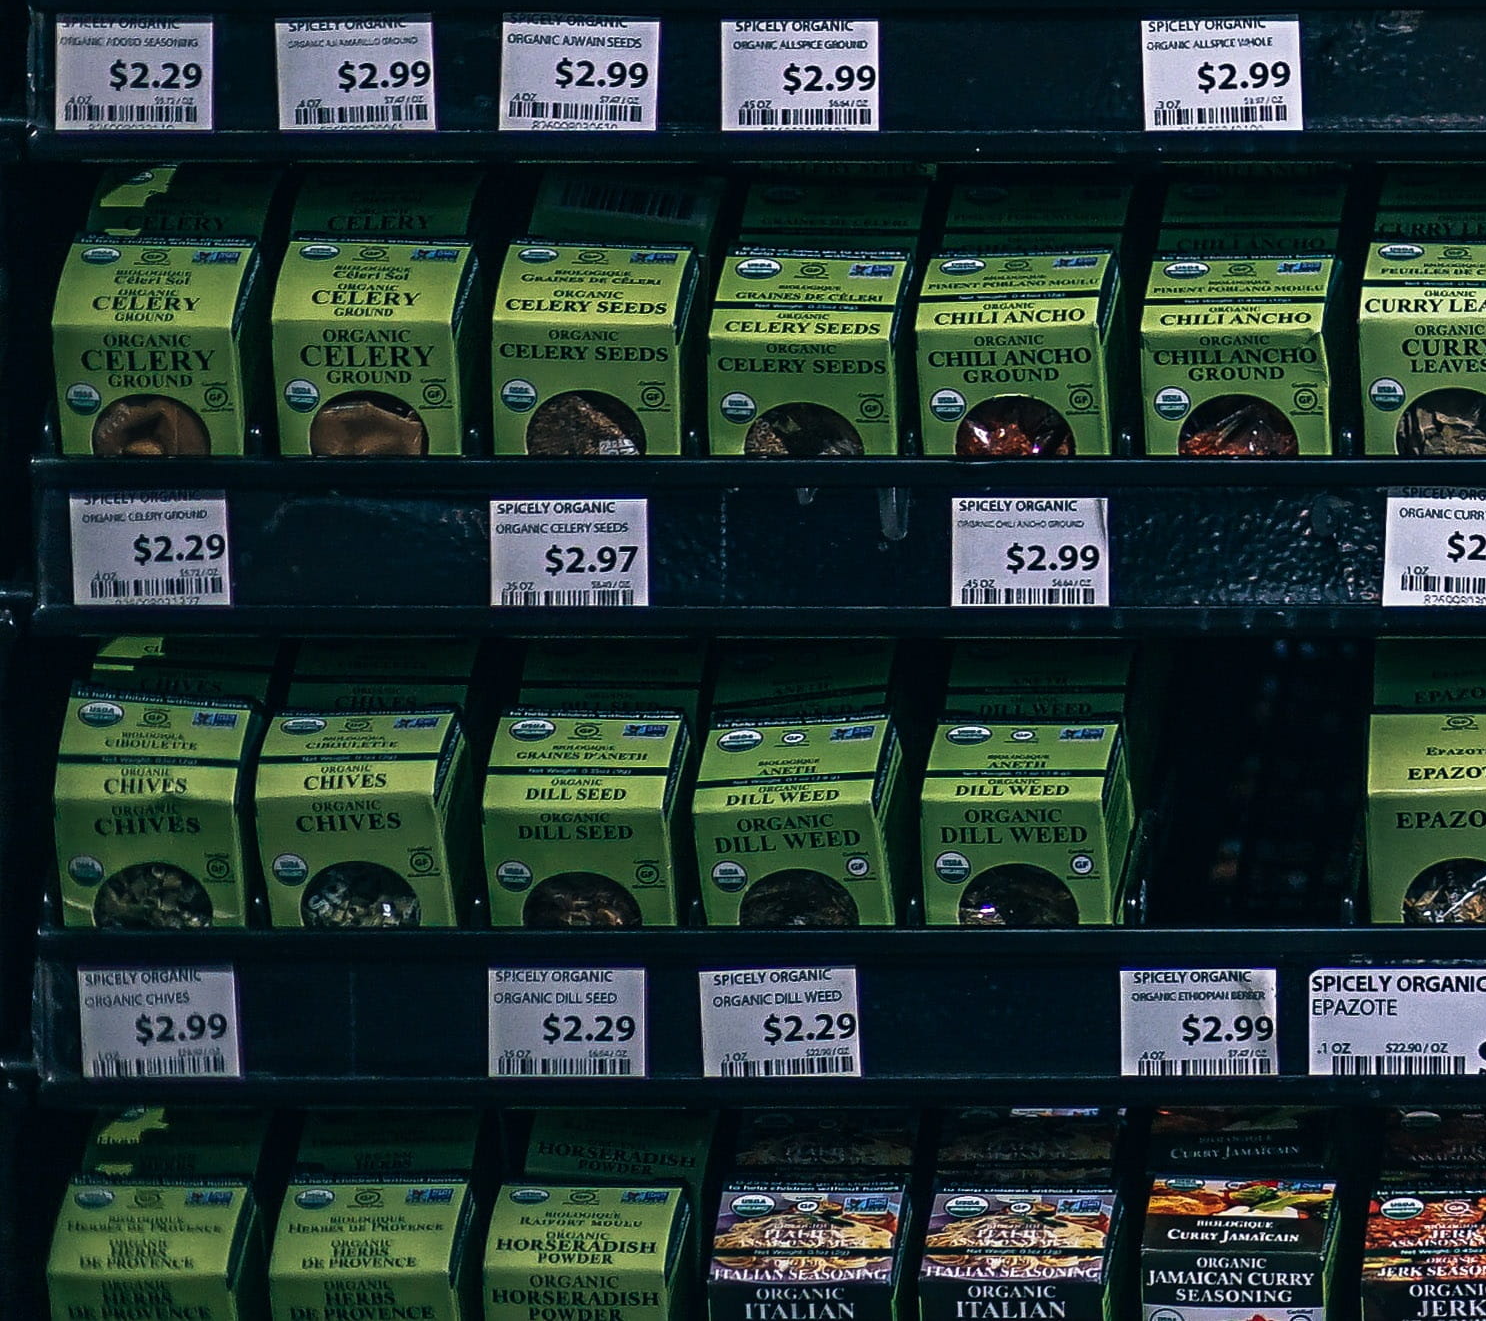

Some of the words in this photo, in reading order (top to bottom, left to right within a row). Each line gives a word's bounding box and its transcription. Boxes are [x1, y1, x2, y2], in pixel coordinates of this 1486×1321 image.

[81, 349, 215, 371] CELERY
[546, 545, 638, 576] $2.97
[296, 813, 401, 832] CHIVES
[941, 827, 1003, 844] DILL
[1009, 826, 1087, 843] WEED
[1312, 976, 1391, 993] SPICELY
[1312, 999, 1397, 1016] EPAZOTE
[1147, 1270, 1242, 1285] JAMAICAN
[1248, 1272, 1314, 1285] CURRY
[492, 1288, 659, 1306] HORSERADISH
[957, 1301, 1065, 1318] ITALIAN
